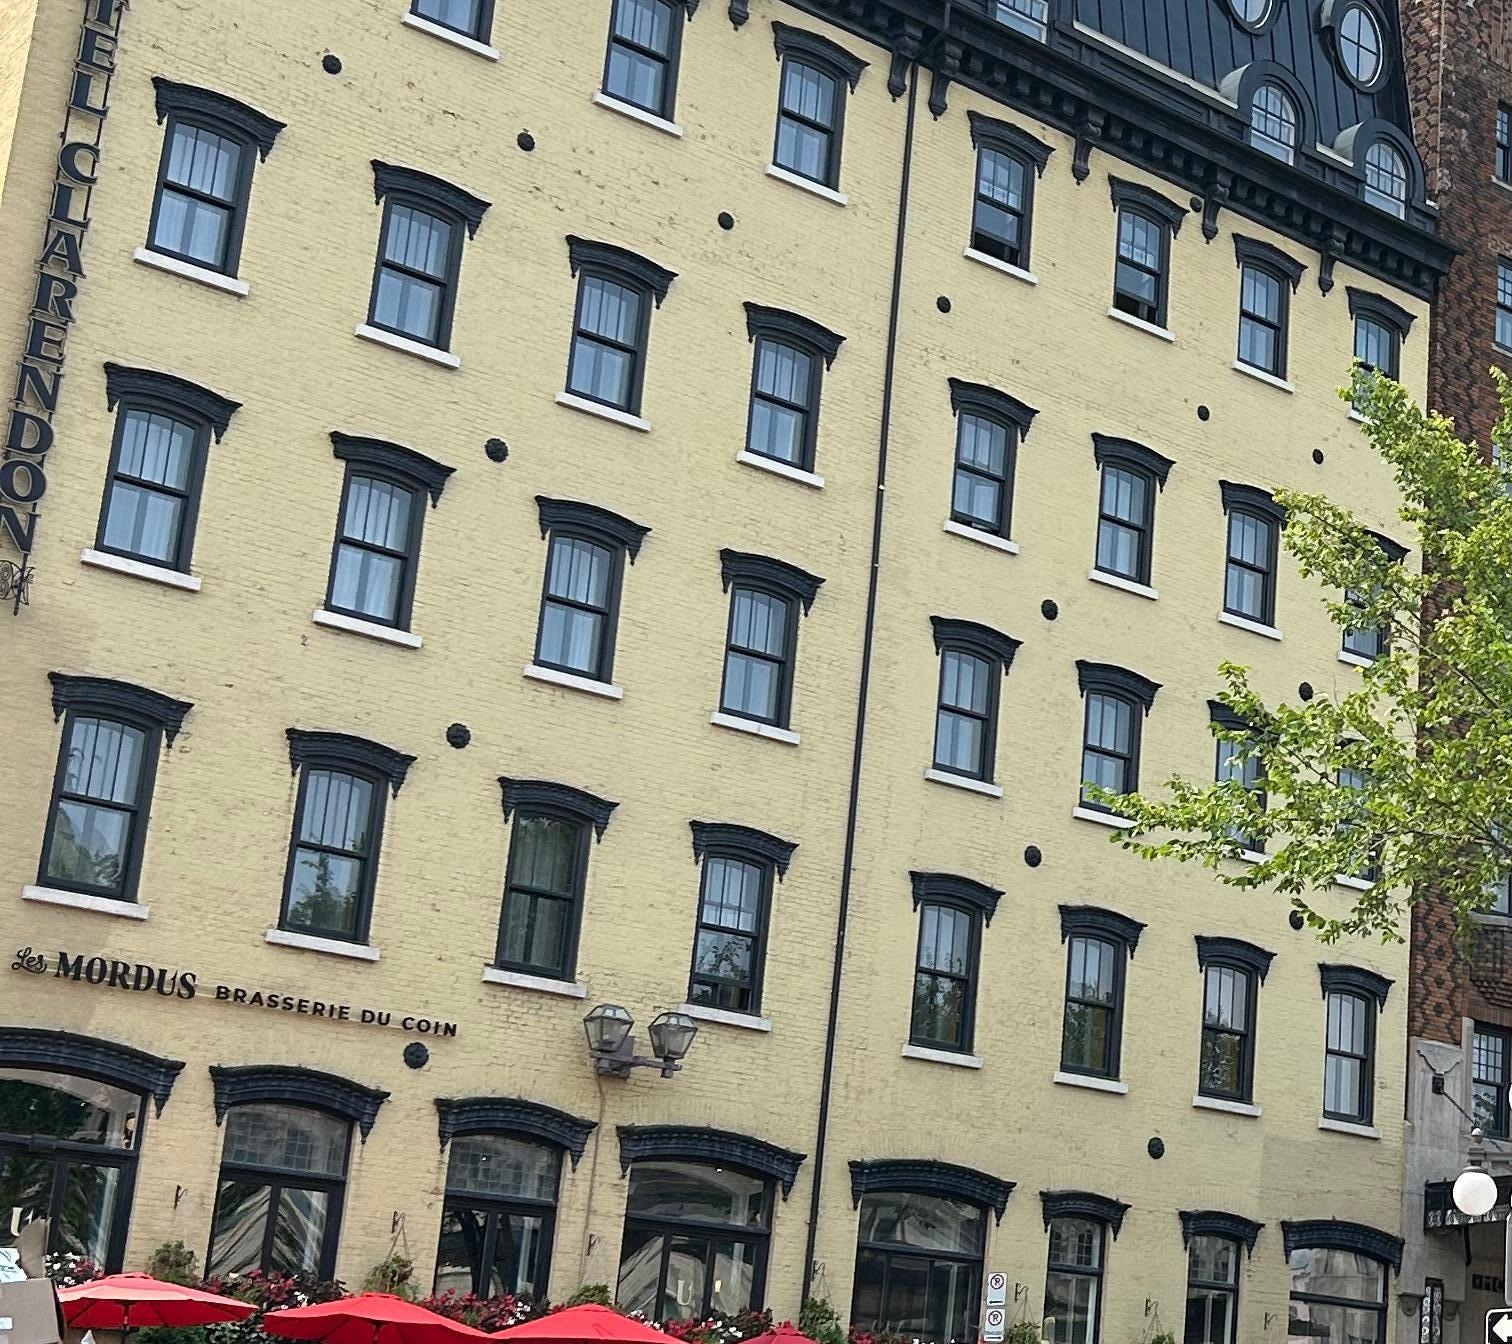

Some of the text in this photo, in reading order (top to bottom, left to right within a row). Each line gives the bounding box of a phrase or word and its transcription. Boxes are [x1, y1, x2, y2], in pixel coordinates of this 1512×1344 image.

[0, 140, 101, 555] CLARENDON
[11, 946, 196, 1000] Les MORDUS
[215, 985, 457, 1038] BRASSERIE DU COIN
